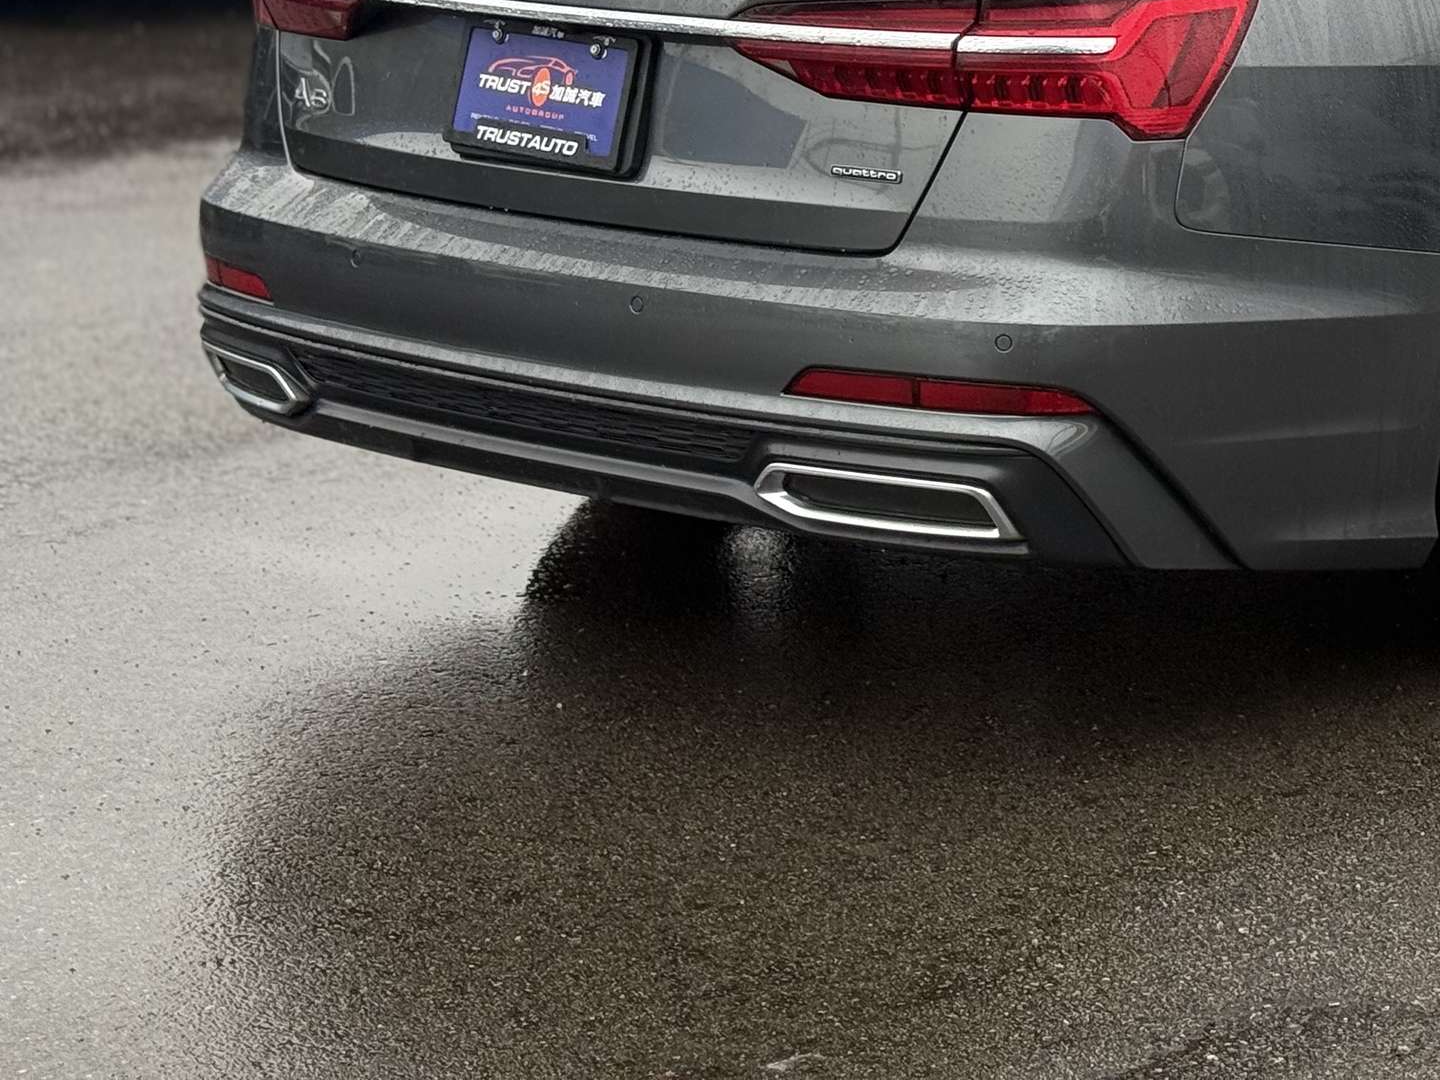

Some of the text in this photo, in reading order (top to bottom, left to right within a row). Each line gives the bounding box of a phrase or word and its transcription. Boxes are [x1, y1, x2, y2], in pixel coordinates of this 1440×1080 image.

[294, 77, 327, 108] A6
[479, 73, 532, 95] TRUST
[505, 104, 565, 120] AUTOGROUP
[476, 125, 579, 156] TRUSTAUTO
[832, 166, 897, 181] quattro
